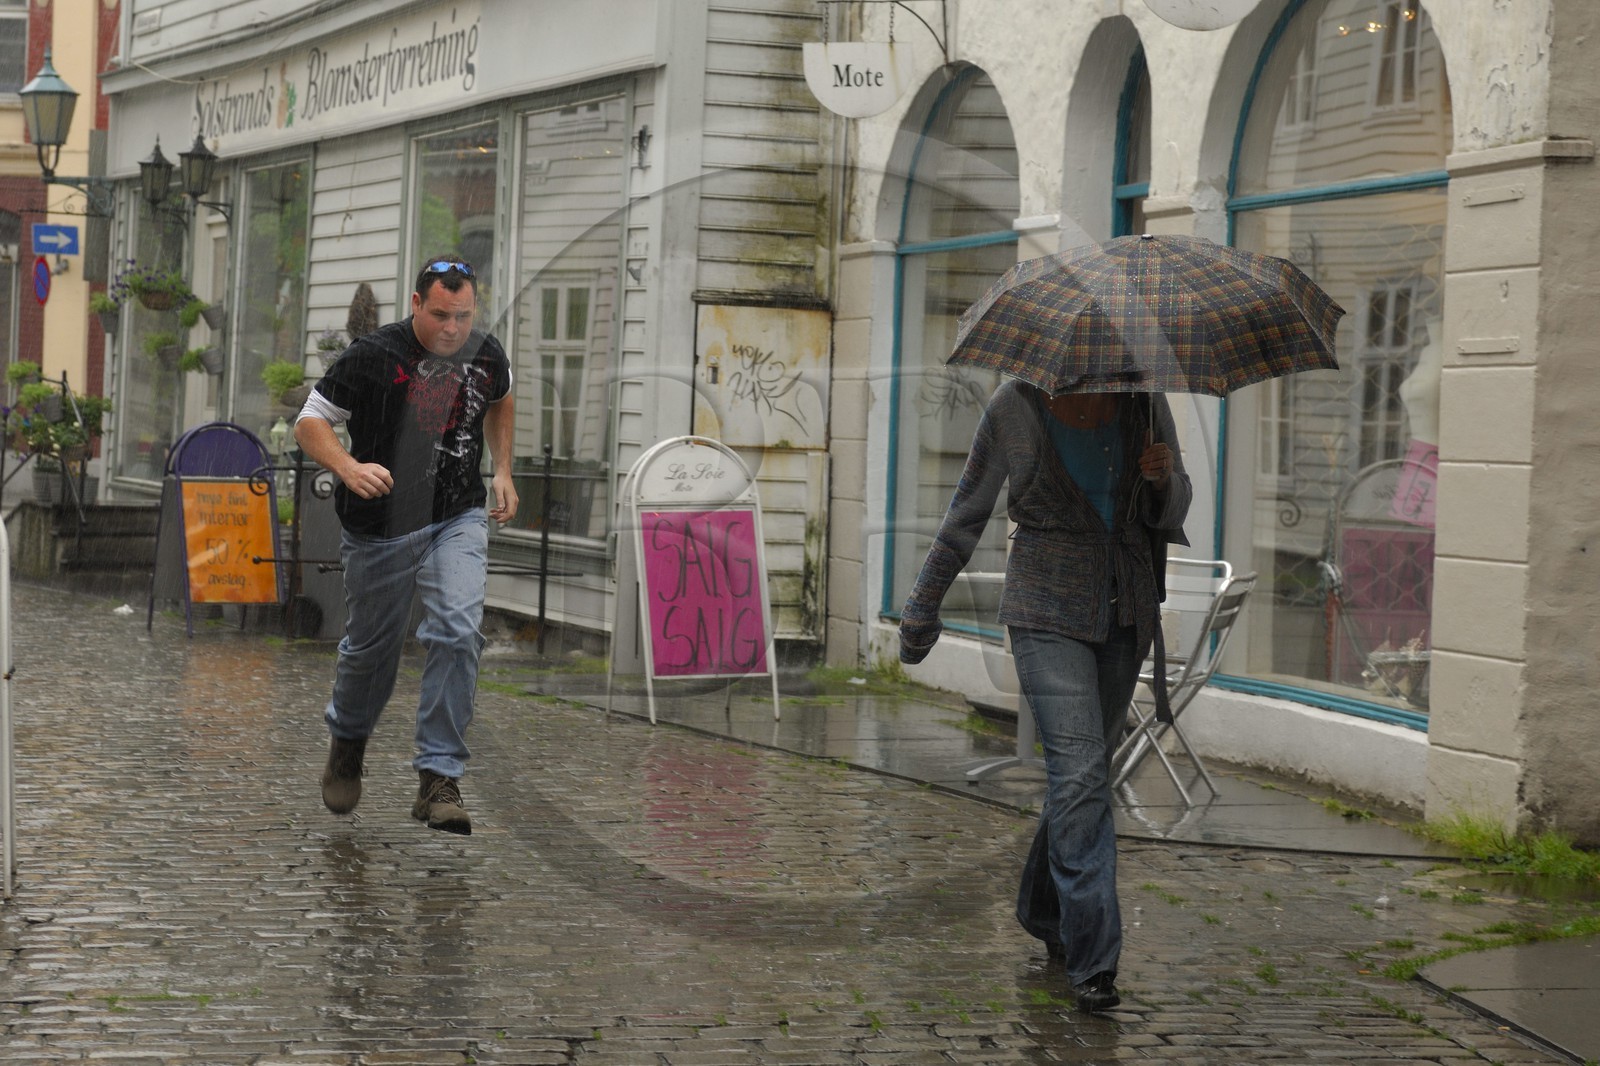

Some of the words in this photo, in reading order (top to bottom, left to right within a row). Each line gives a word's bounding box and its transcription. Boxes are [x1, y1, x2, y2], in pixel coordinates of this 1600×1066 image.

[191, 67, 274, 142] Solstrands
[301, 8, 481, 120] Blomsterforretning
[833, 64, 884, 87] Mote
[664, 464, 688, 480] La
[691, 463, 725, 480] Soie
[205, 538, 229, 565] 50
[235, 538, 252, 565] %
[651, 518, 753, 602] SALG
[662, 605, 758, 671] SALG
